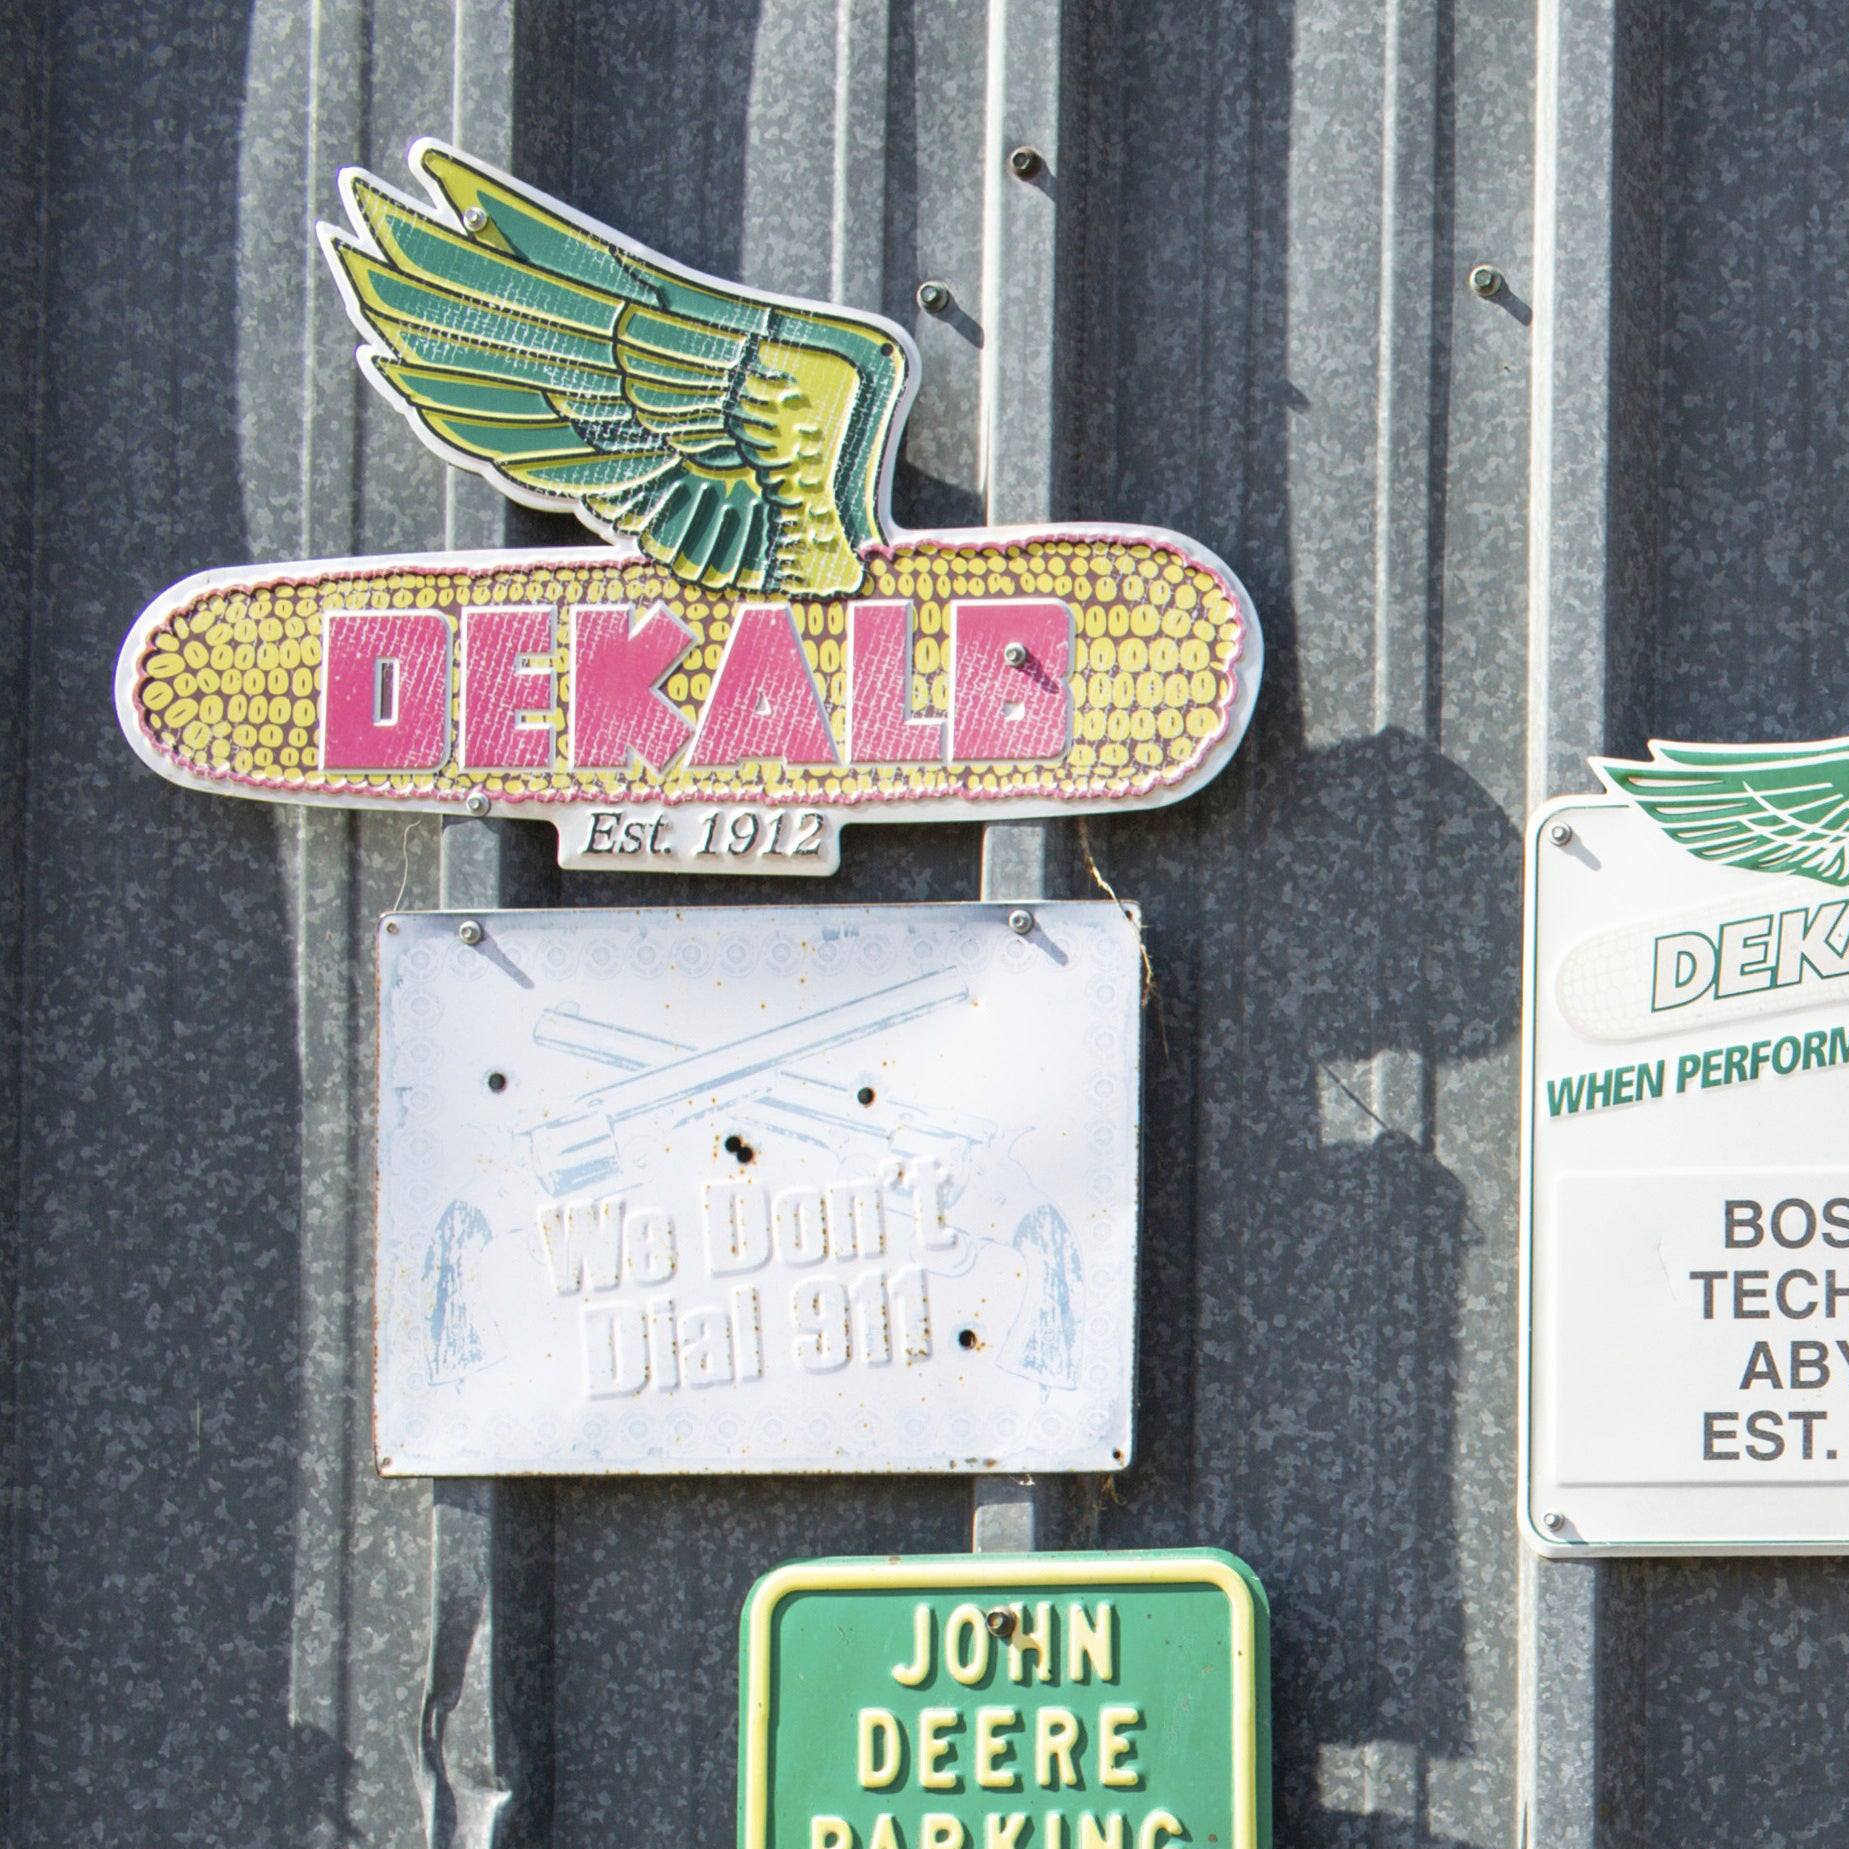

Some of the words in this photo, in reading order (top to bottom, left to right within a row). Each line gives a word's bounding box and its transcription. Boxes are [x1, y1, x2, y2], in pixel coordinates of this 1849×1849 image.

[318, 598, 1077, 776] DEKALB
[581, 812, 674, 857] Est.
[697, 811, 825, 858] 1912
[1547, 1059, 1665, 1118] WHEN
[540, 1200, 678, 1298] We
[582, 1285, 760, 1398] Dial
[793, 1264, 932, 1374] 911
[1702, 1411, 1837, 1461] EST.
[892, 1602, 1113, 1688] JOHN
[857, 1706, 1143, 1790] DEERE
